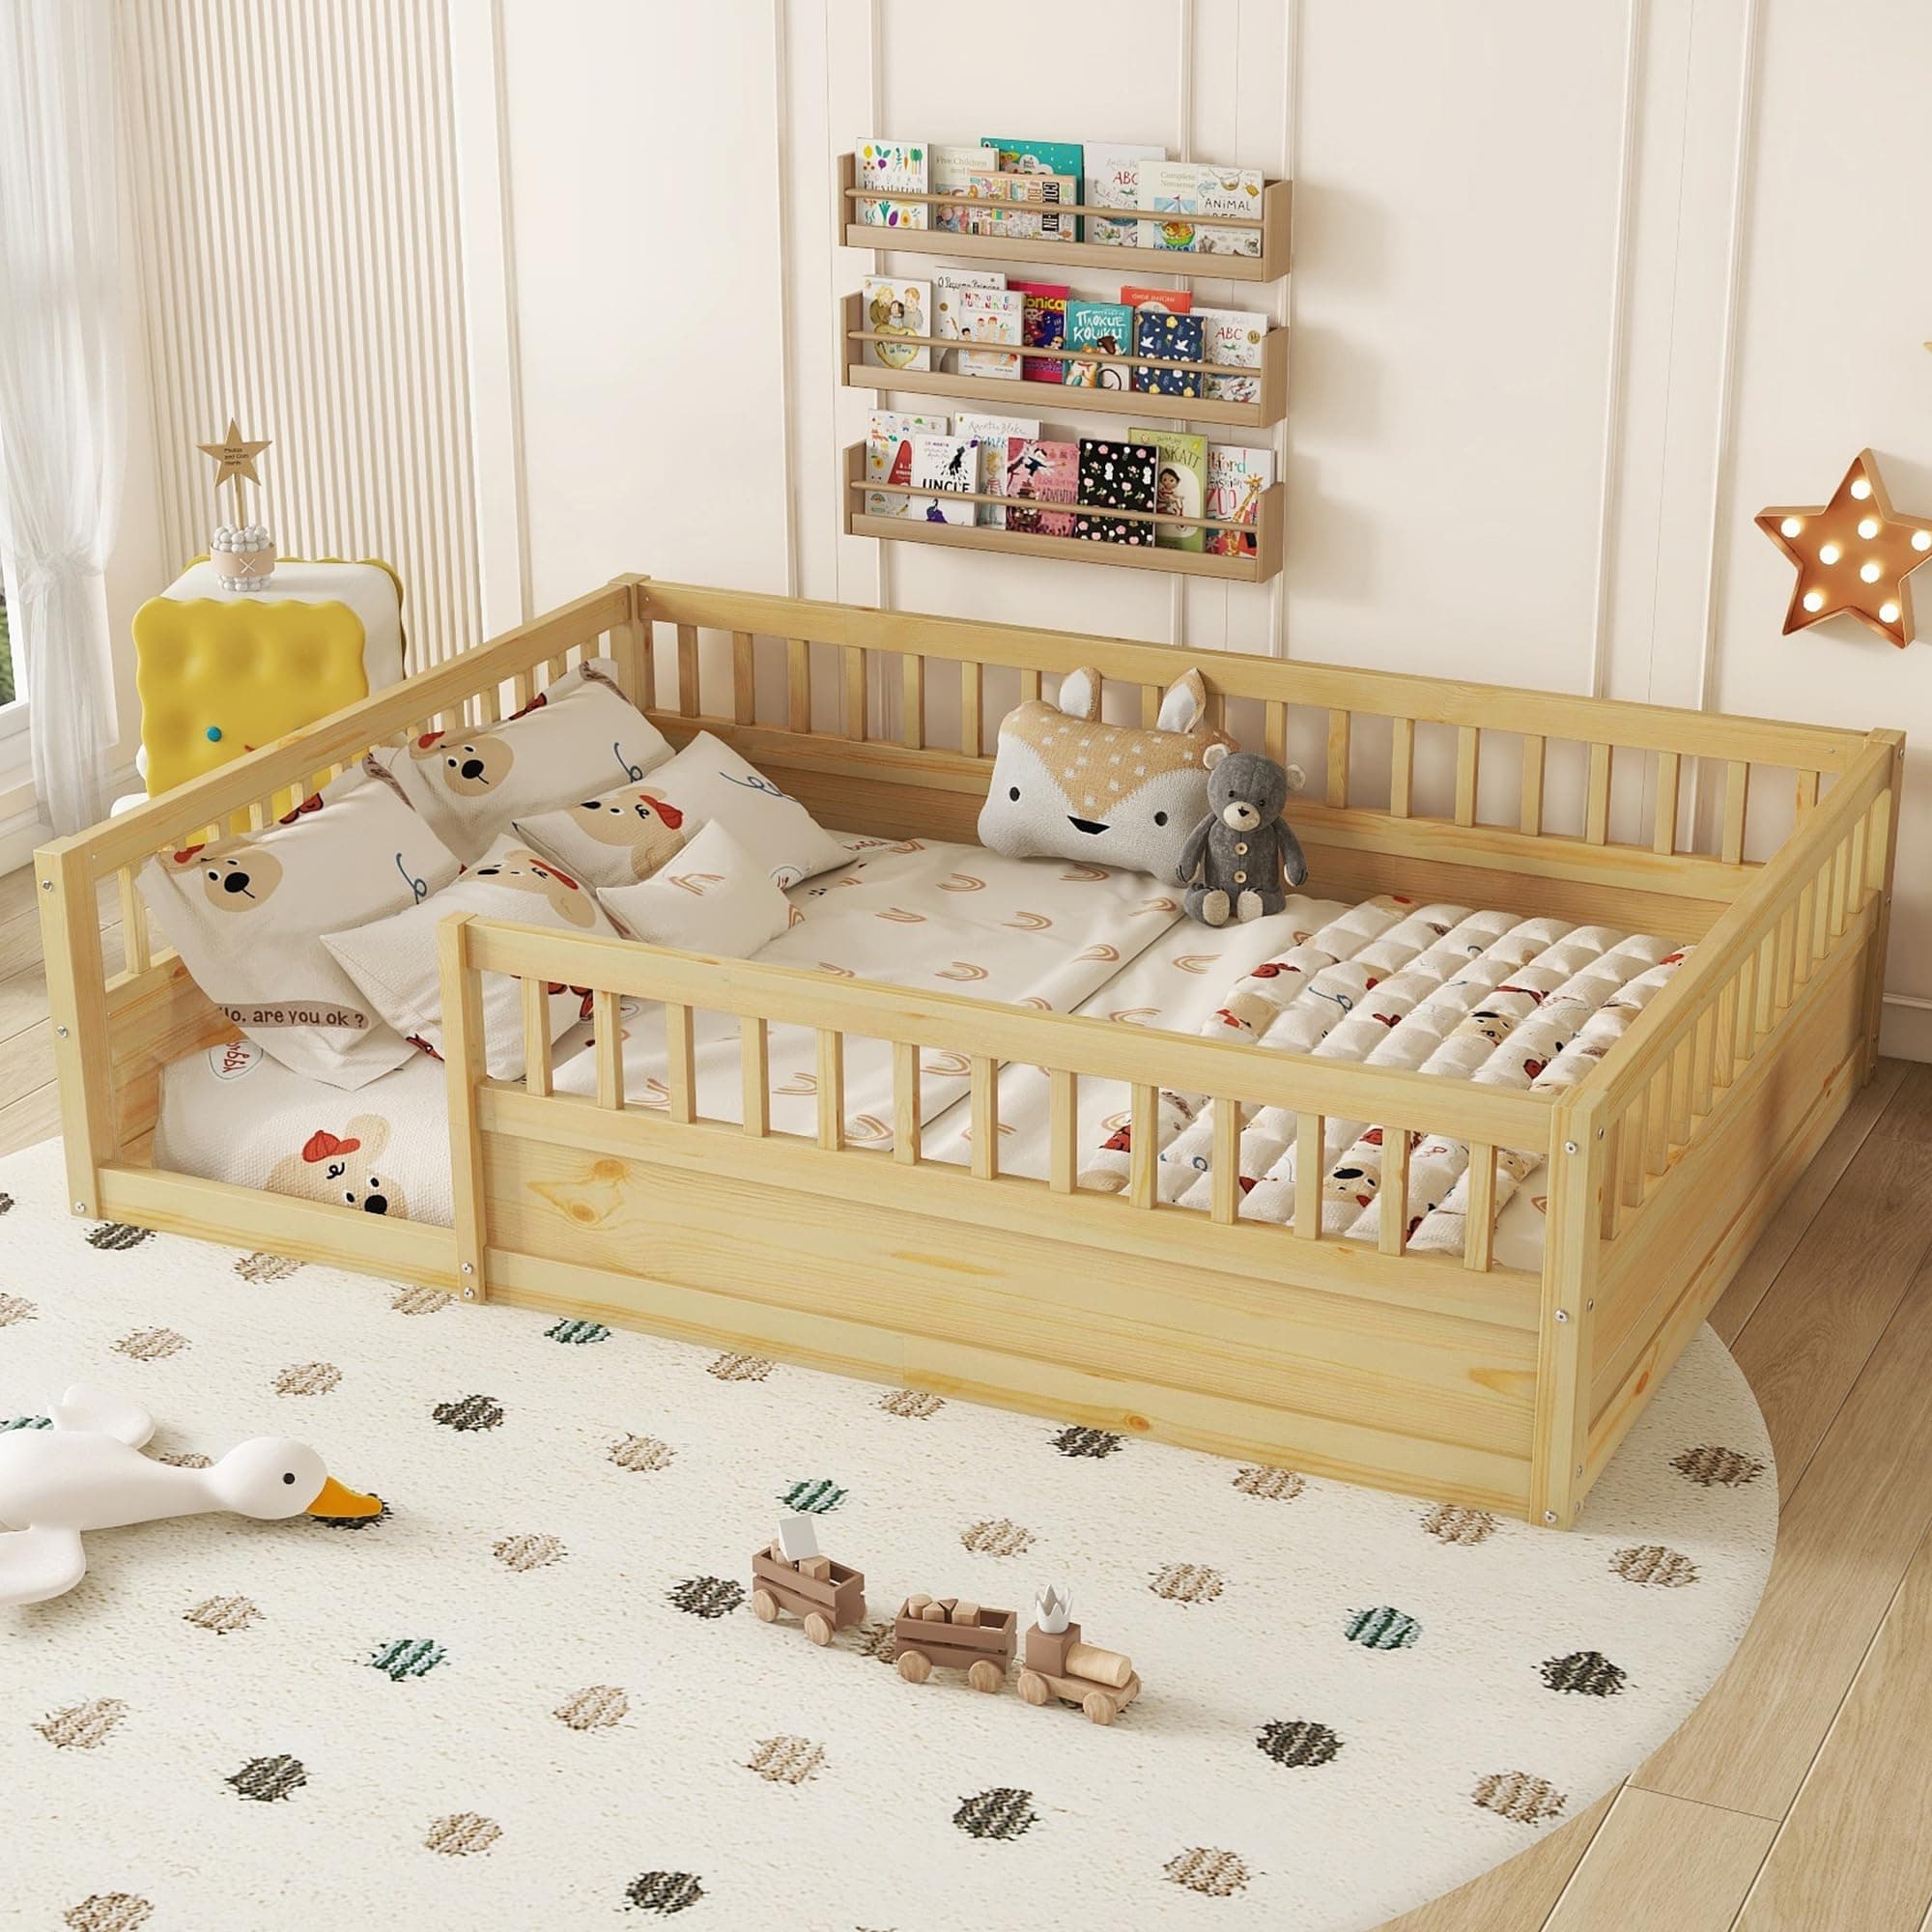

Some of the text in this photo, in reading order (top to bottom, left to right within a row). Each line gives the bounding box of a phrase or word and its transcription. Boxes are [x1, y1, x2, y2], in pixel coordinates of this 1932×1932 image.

[1215, 327, 1243, 340] ABC
[253, 1009, 284, 1023] are
[288, 1009, 320, 1024] you
[326, 1010, 349, 1026] ok
[355, 1013, 364, 1028] ?
